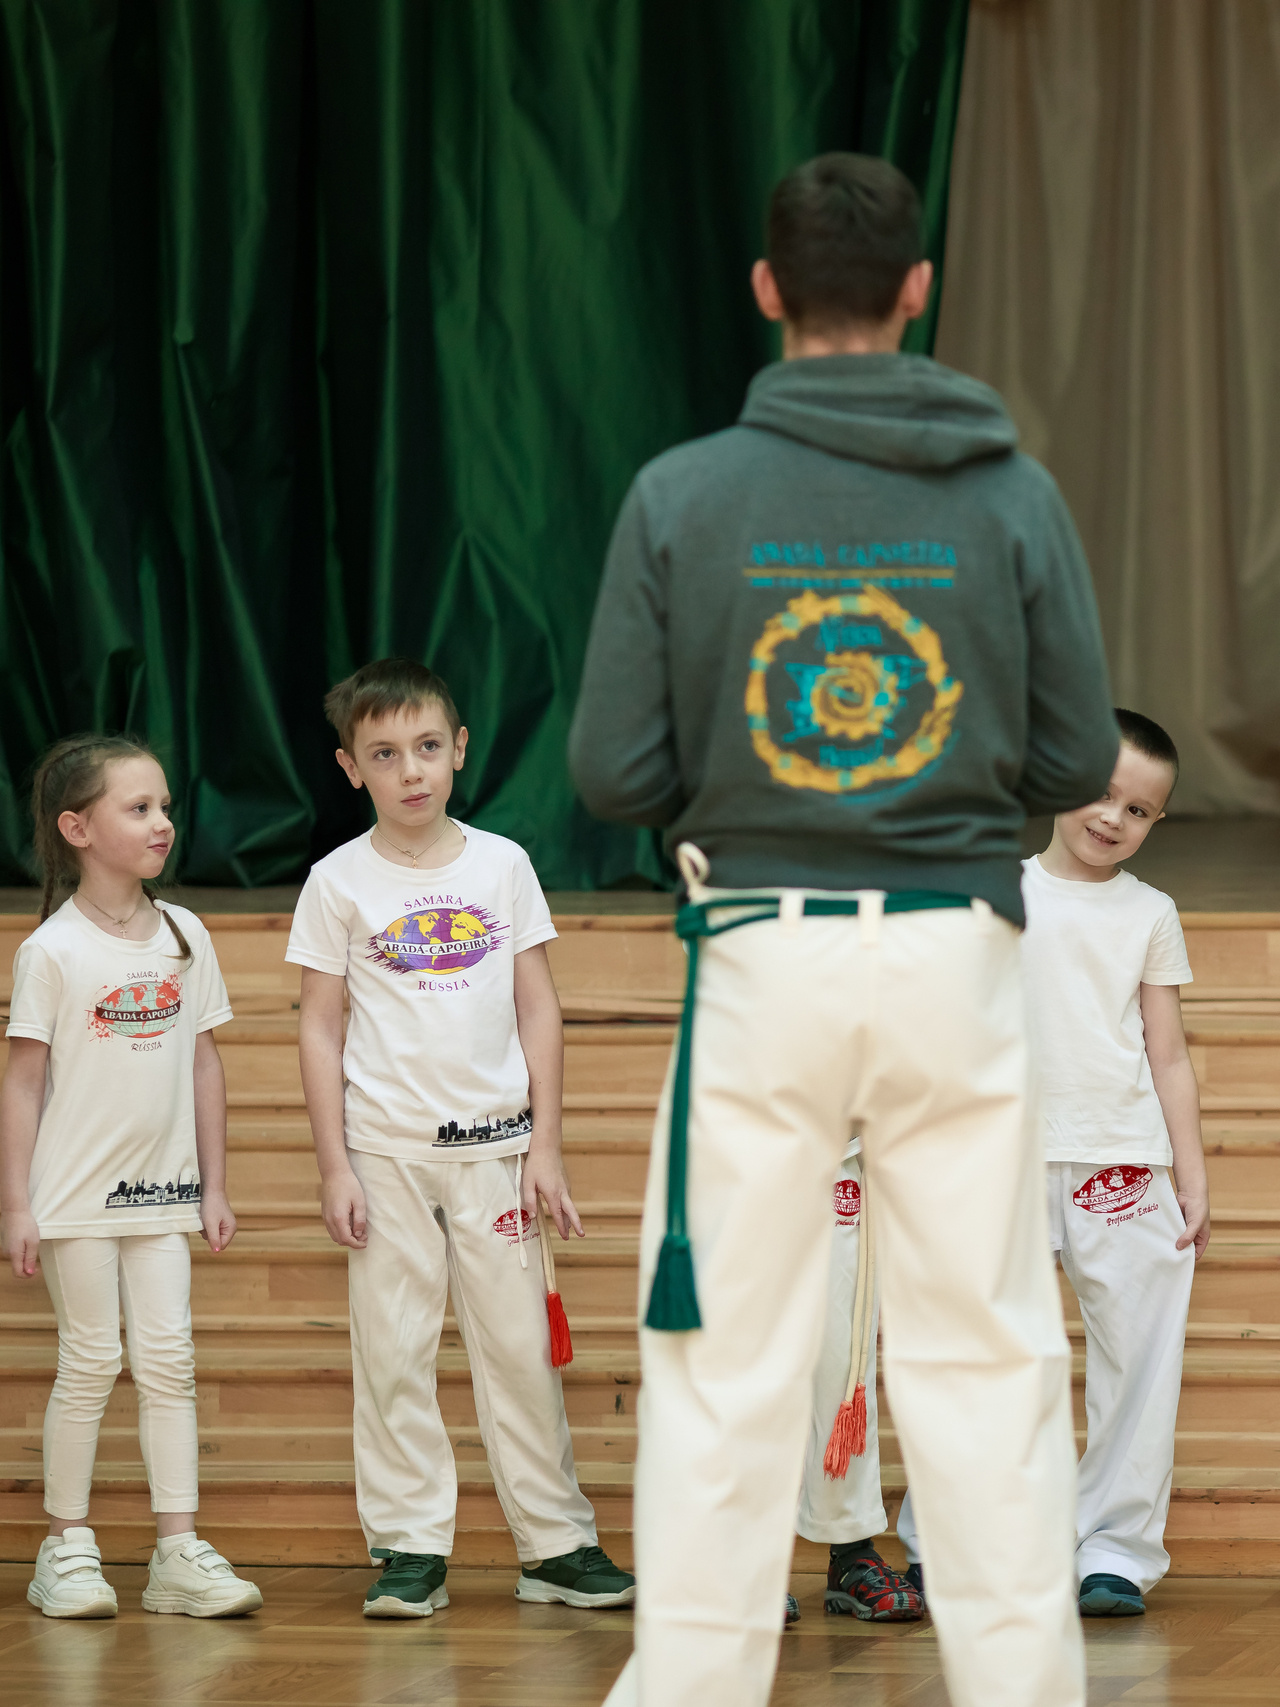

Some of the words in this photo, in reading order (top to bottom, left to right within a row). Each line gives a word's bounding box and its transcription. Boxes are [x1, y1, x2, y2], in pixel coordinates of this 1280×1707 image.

[404, 894, 464, 910] SAMARA
[383, 938, 488, 955] ABADÁ-CAPOEIRA
[126, 970, 159, 980] SAMARA
[417, 978, 470, 992] RÚSSIA
[101, 1005, 179, 1021] ABADÁ-CAPOEIRA
[131, 1041, 163, 1052] RÚSSIA
[1106, 1212, 1135, 1227] Professor
